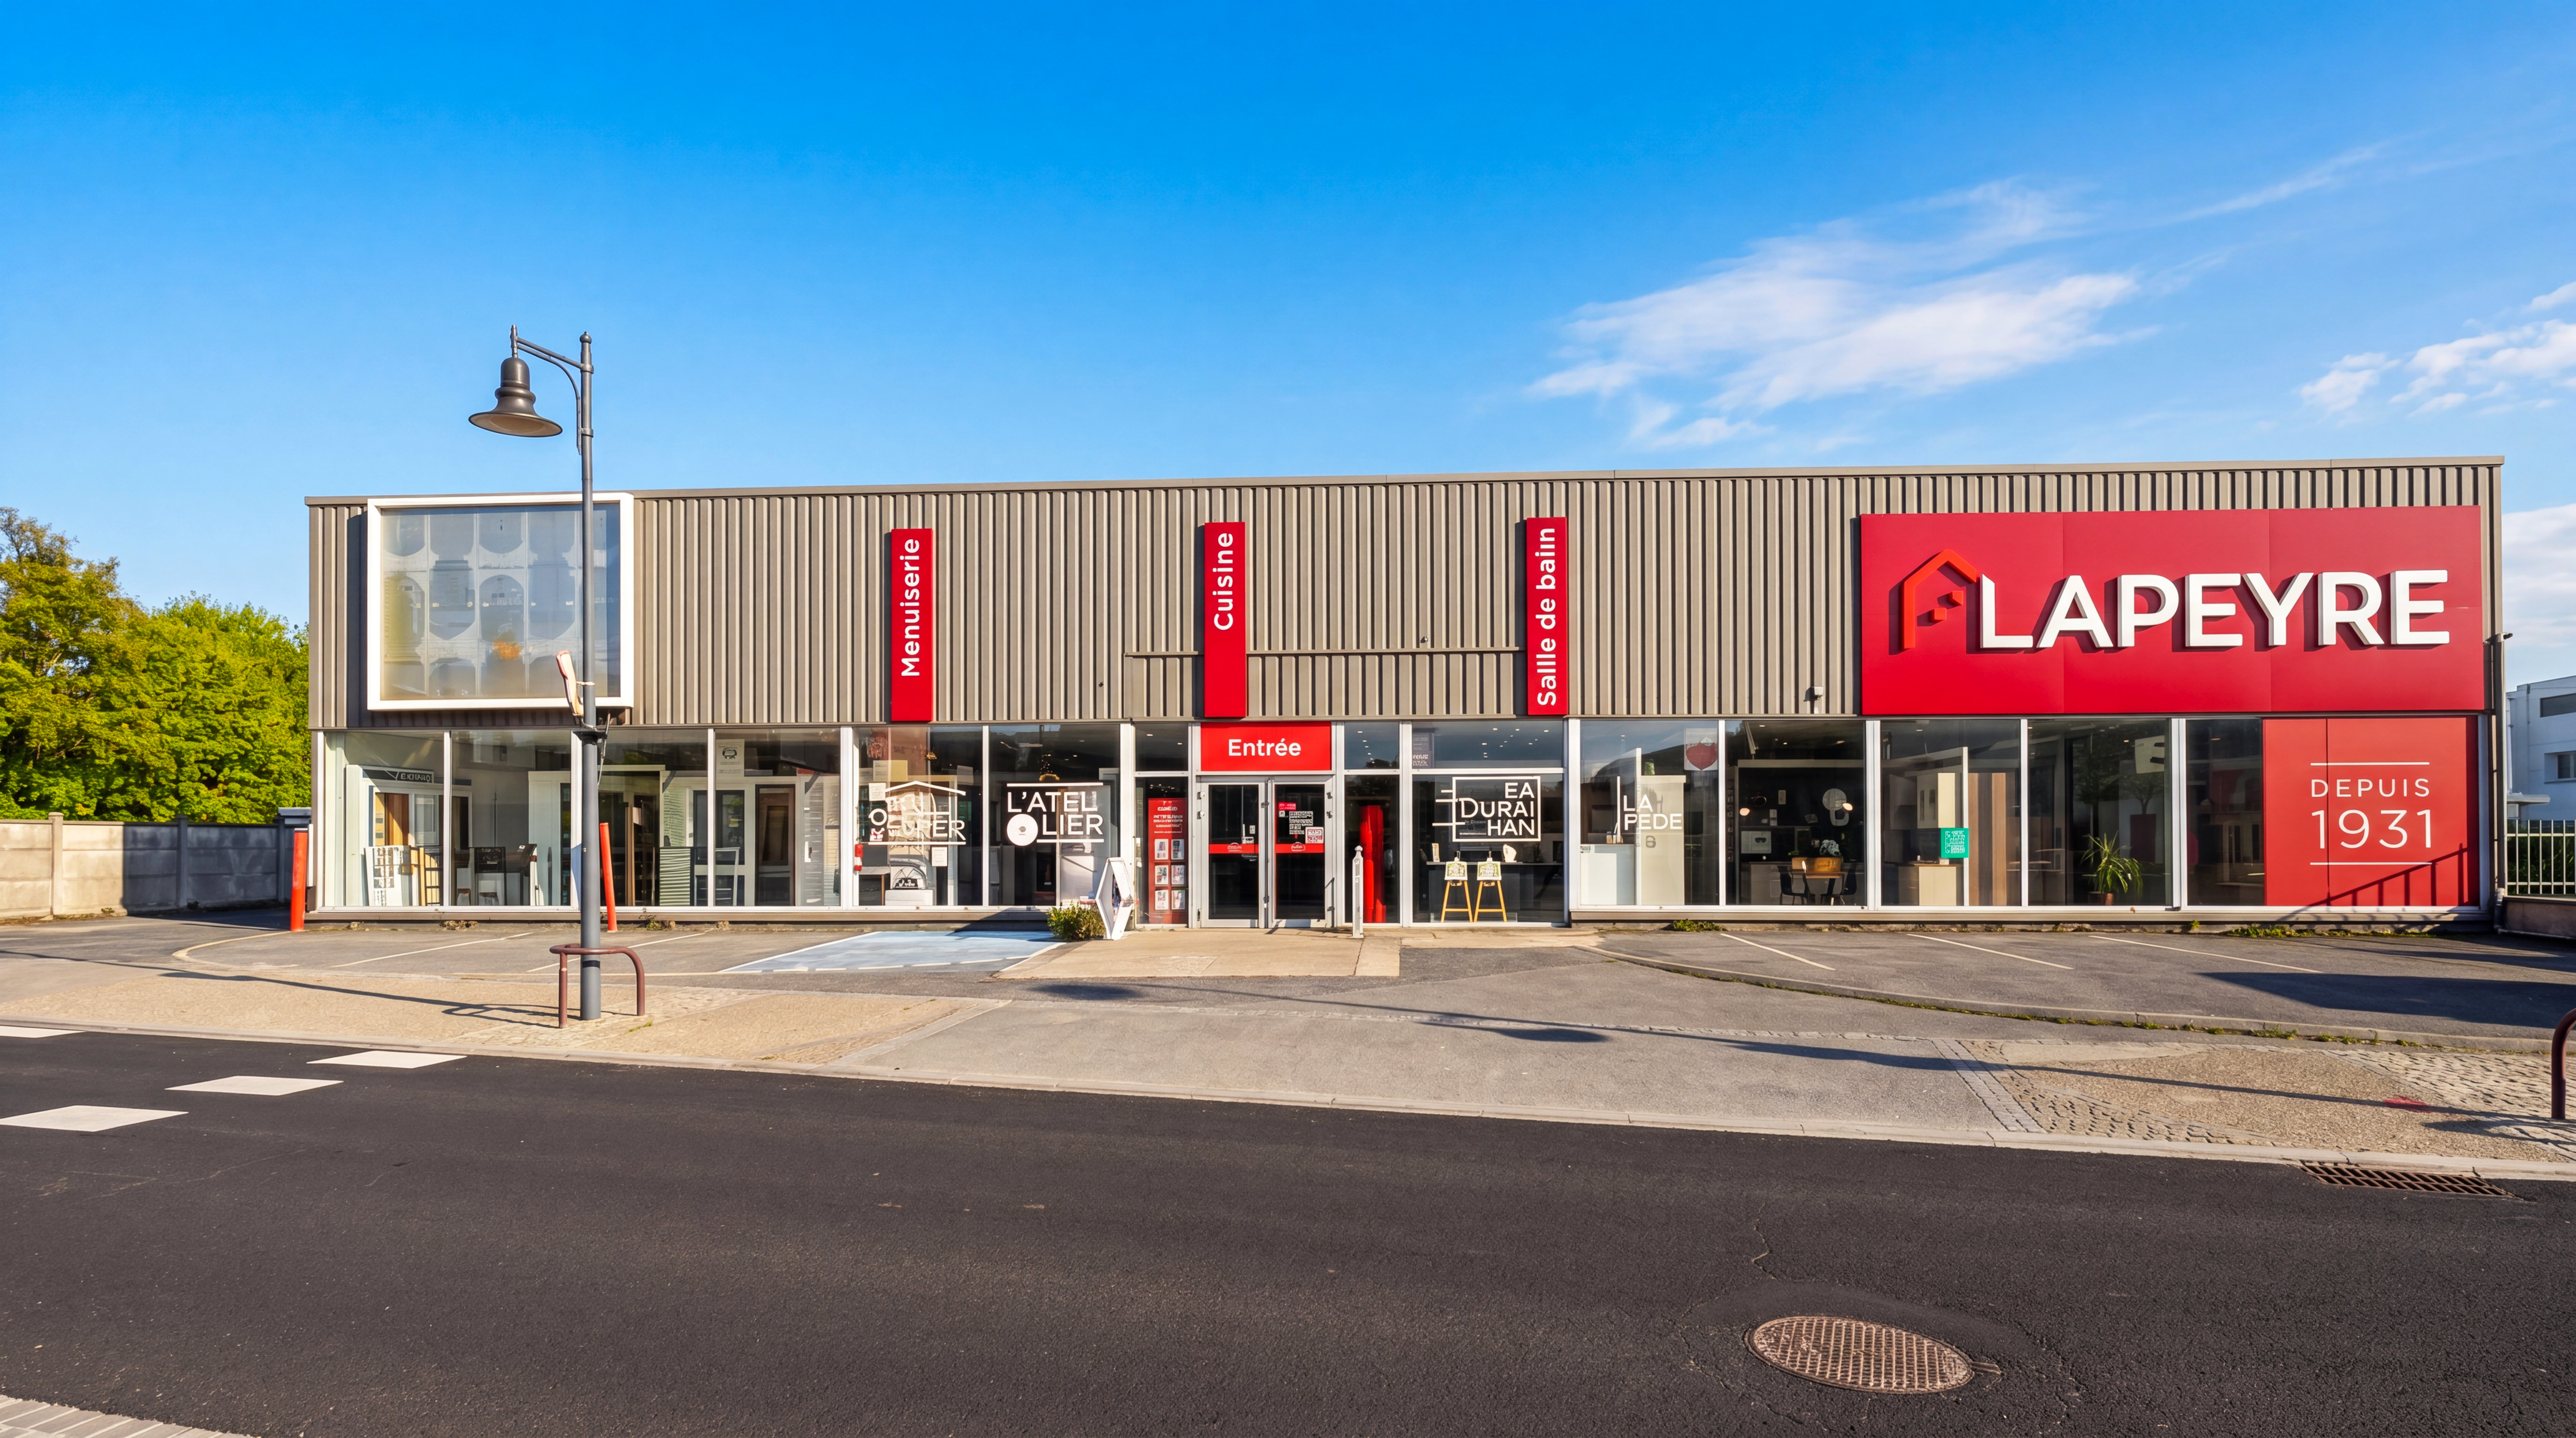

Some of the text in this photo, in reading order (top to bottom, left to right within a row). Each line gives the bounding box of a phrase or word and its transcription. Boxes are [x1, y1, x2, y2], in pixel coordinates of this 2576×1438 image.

[1212, 530, 1234, 631] Cuisine
[900, 538, 920, 676] Menuiserie
[1535, 598, 1556, 630] de
[1980, 569, 2451, 648] LAPEYRE
[1228, 737, 1302, 756] Entrée
[1623, 794, 1654, 812] LA
[2311, 778, 2430, 797] DEPUIS
[1624, 813, 1683, 830] PEDE
[2311, 809, 2431, 849] 1931
